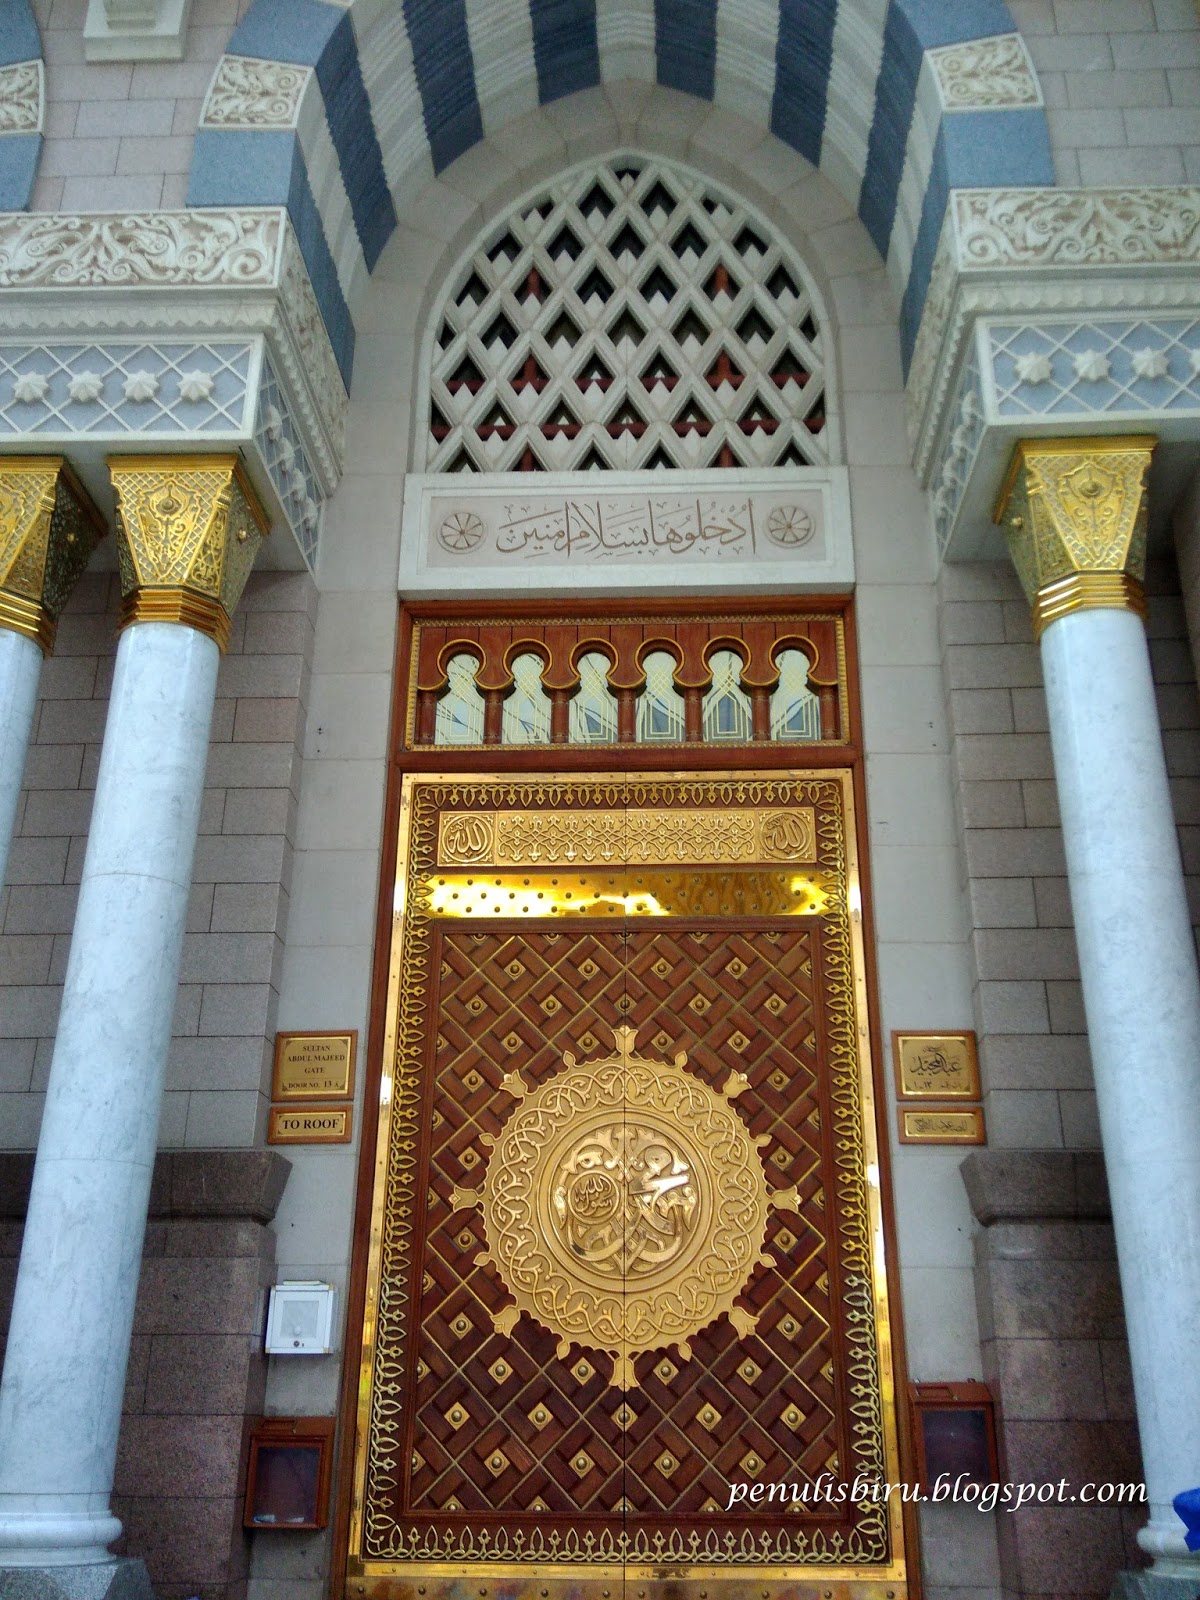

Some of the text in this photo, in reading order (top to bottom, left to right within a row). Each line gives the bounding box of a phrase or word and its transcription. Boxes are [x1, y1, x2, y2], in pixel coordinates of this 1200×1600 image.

[324, 1080, 332, 1088] 13
[282, 1118, 340, 1129] TO ROOF
